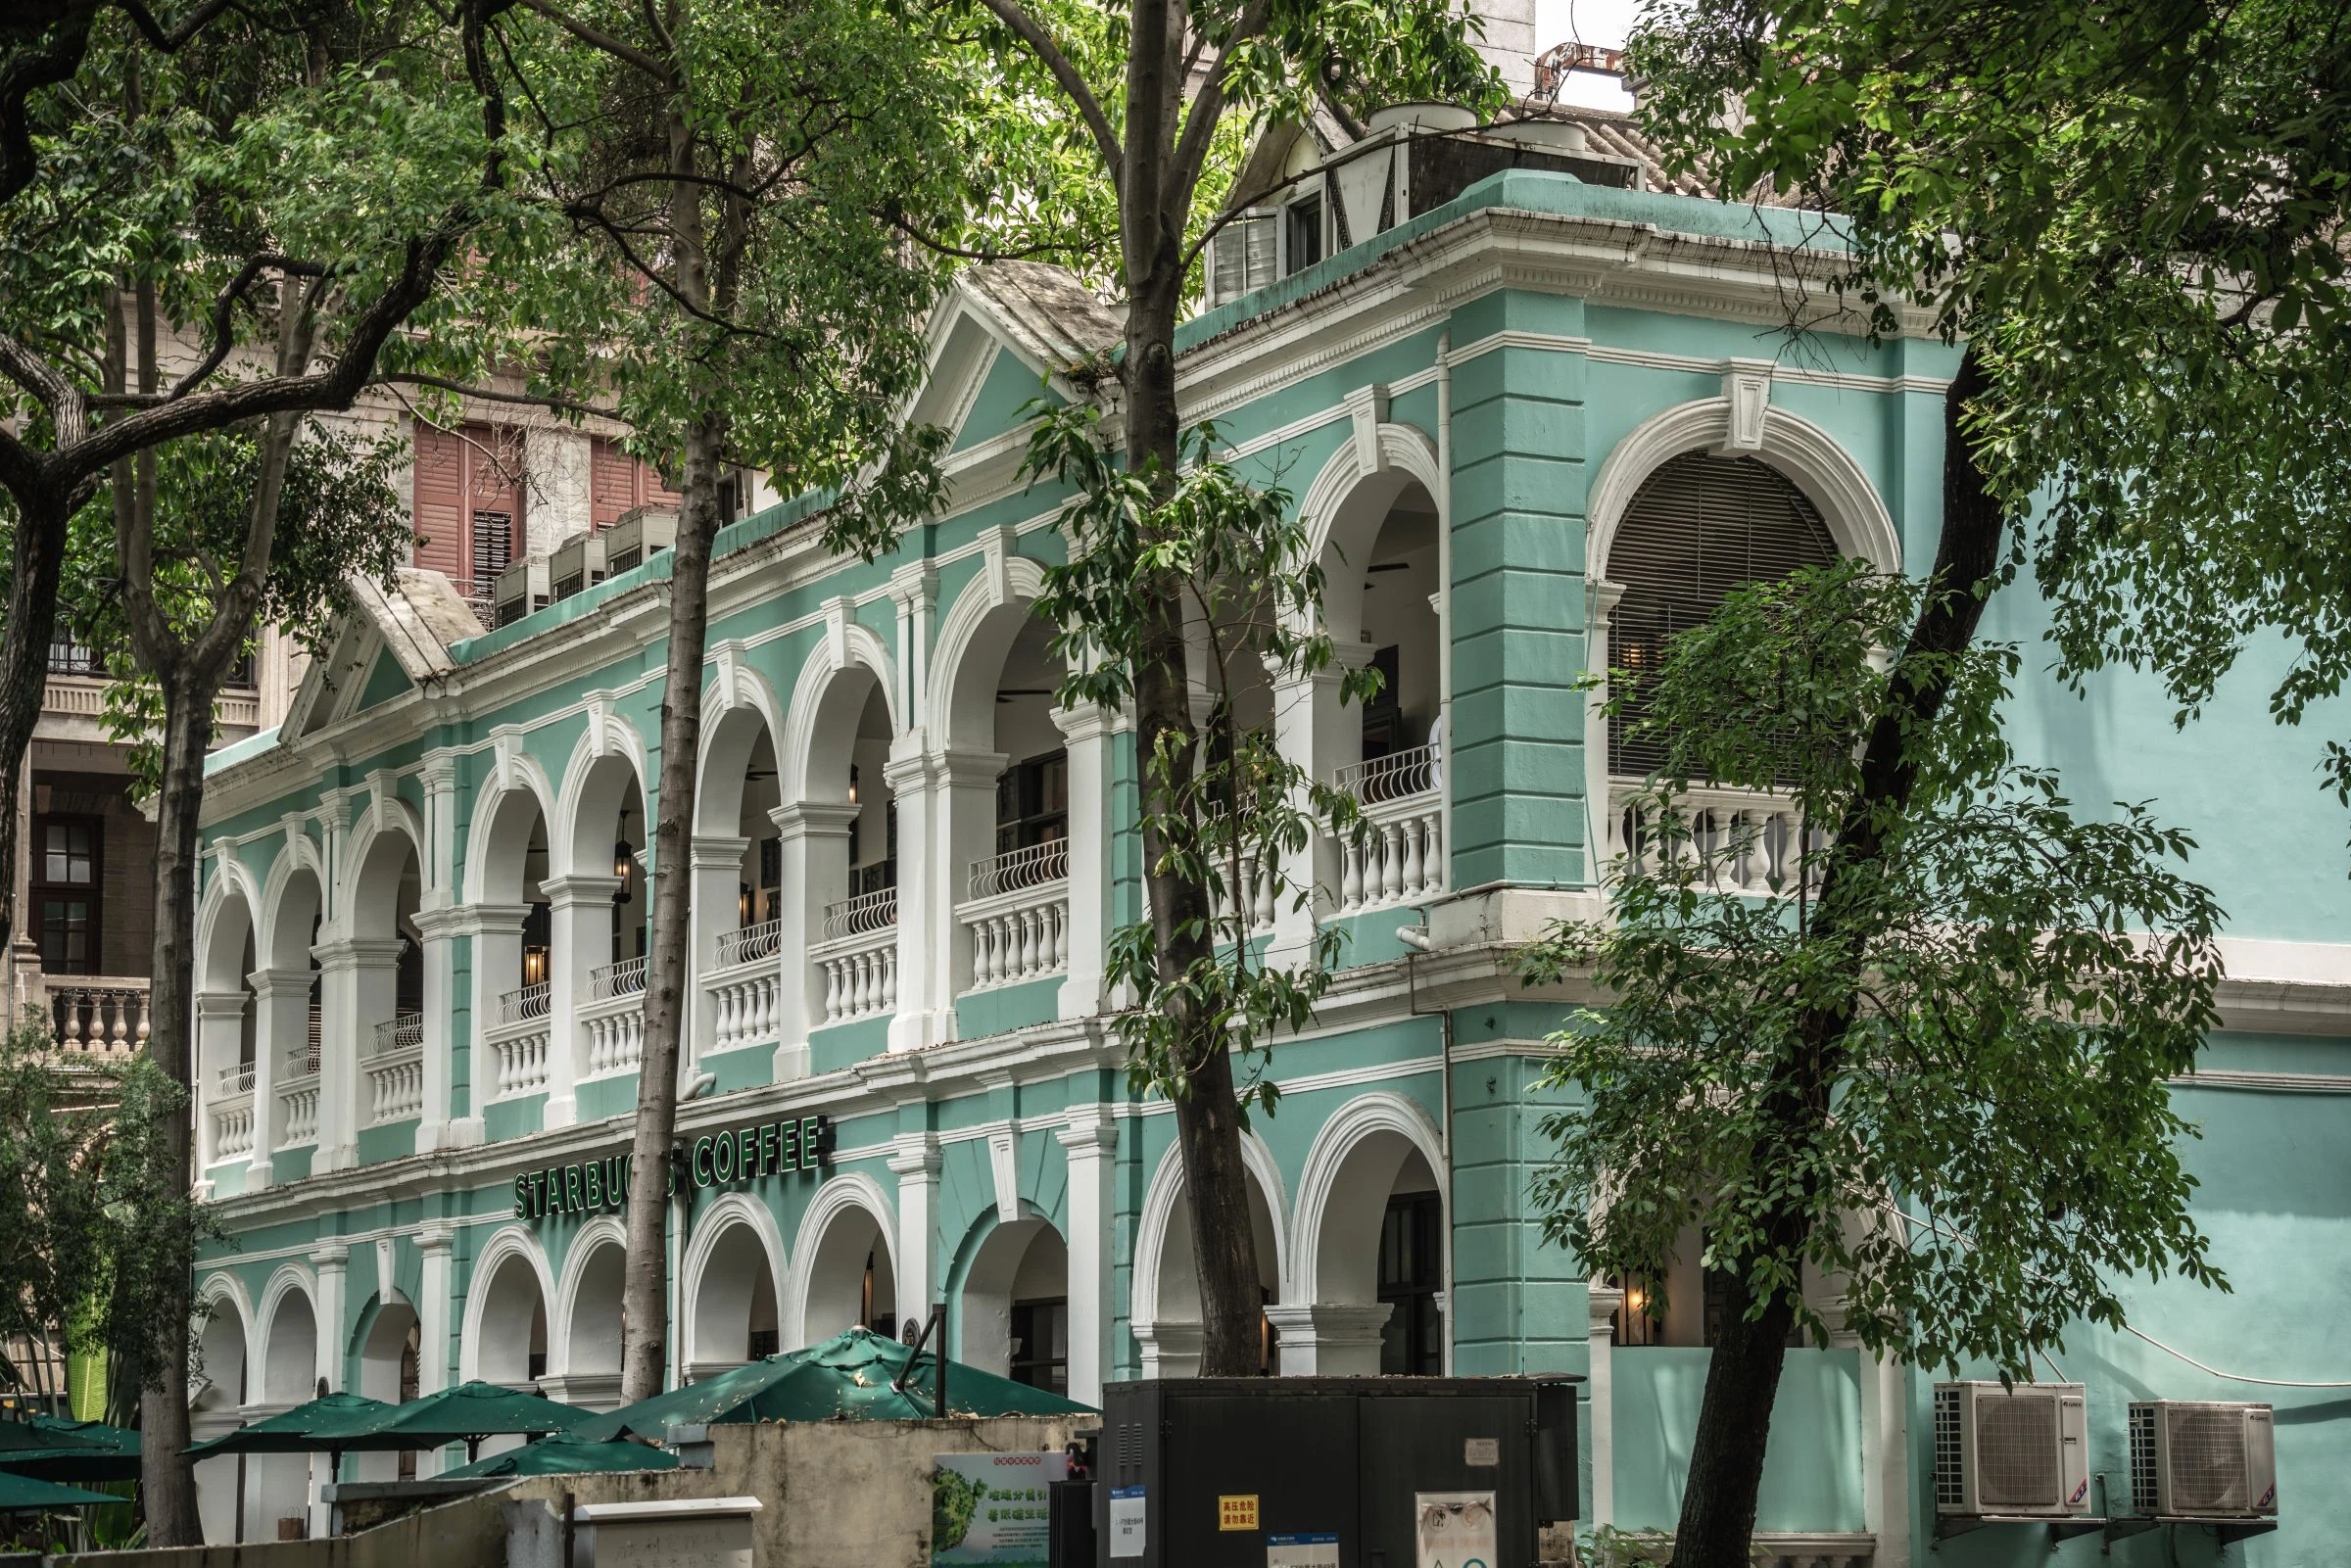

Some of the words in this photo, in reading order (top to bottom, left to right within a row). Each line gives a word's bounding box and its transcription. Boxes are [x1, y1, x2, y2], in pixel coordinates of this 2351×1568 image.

[693, 1116, 820, 1188] COFFEE
[1223, 1500, 1255, 1512] 高压危险
[1223, 1513, 1255, 1525] 请勿靠近
